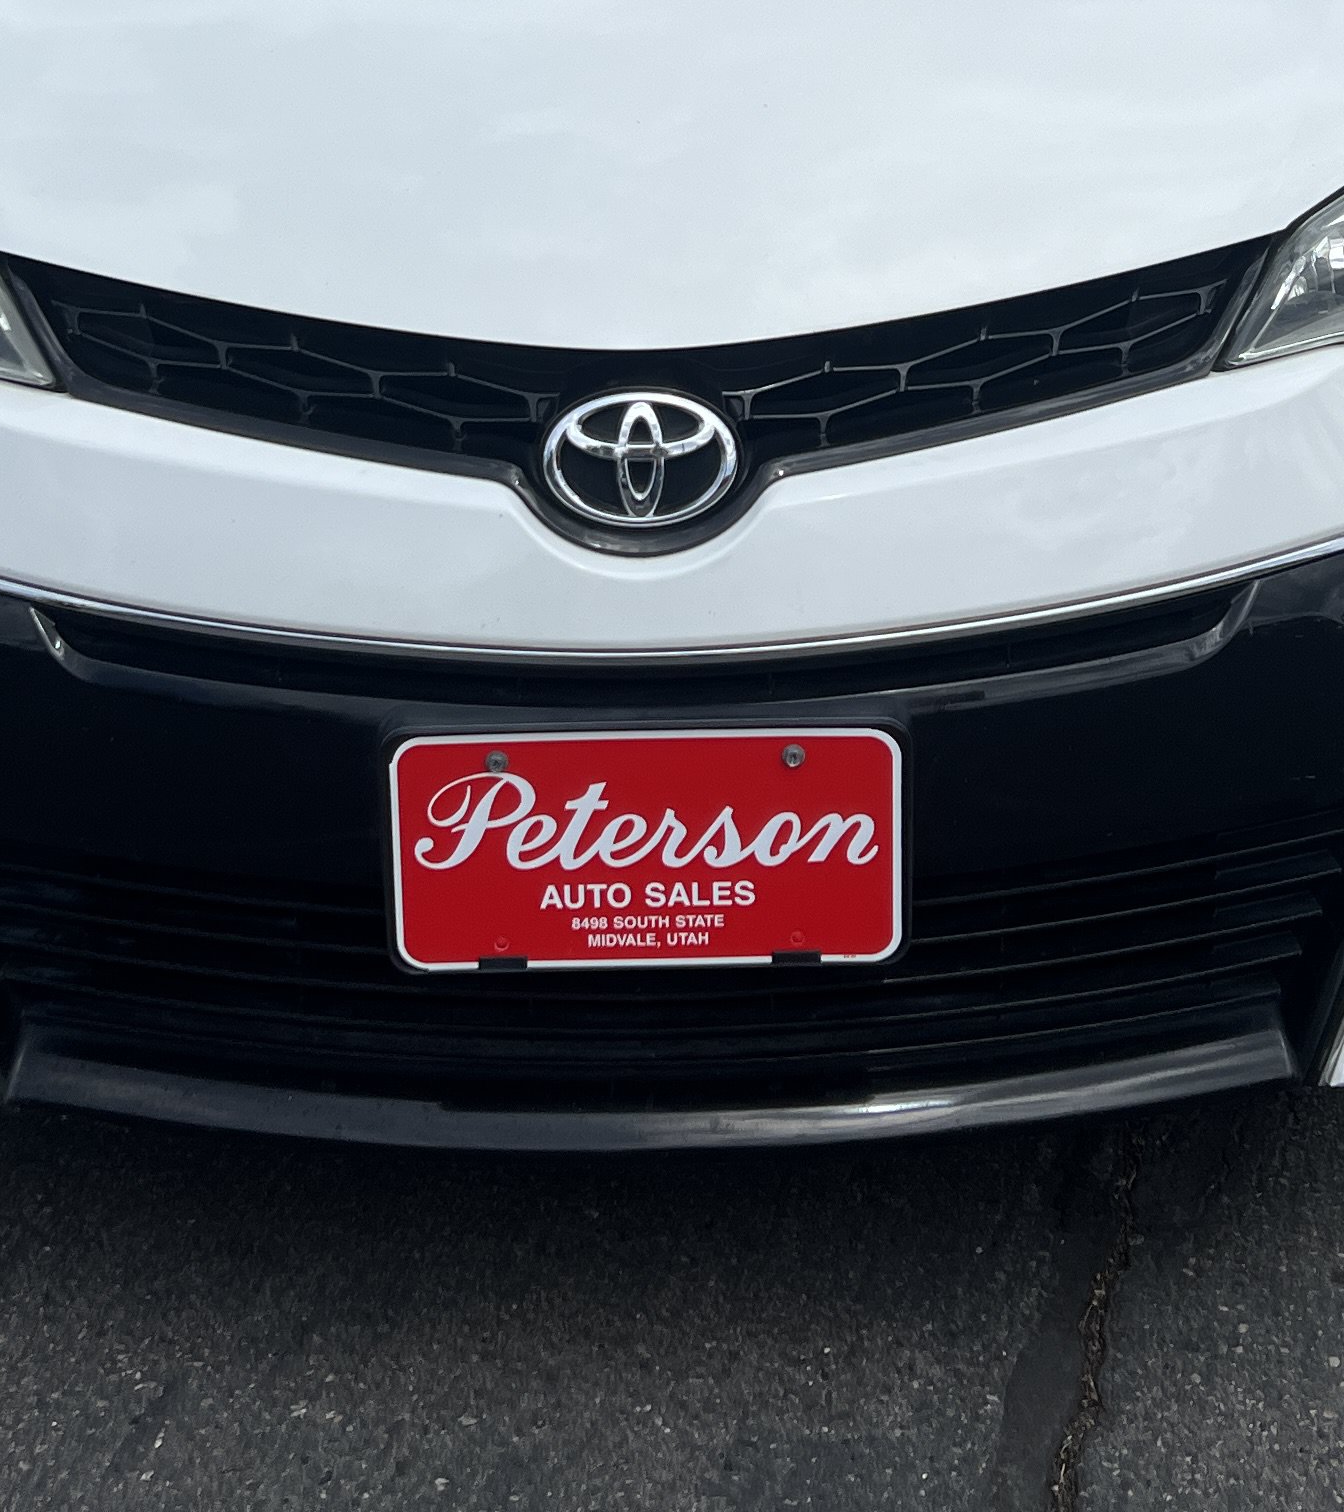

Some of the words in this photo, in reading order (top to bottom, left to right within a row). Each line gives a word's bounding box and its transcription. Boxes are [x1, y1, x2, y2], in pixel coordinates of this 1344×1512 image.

[413, 771, 880, 872] Peterson
[539, 883, 632, 910] AUTO
[644, 881, 757, 908] SALES
[571, 916, 609, 930] 8498
[613, 915, 670, 930] SOUTH
[675, 914, 725, 928] STATE
[587, 933, 661, 949] MIDVALE,
[667, 932, 709, 946] UTAH
